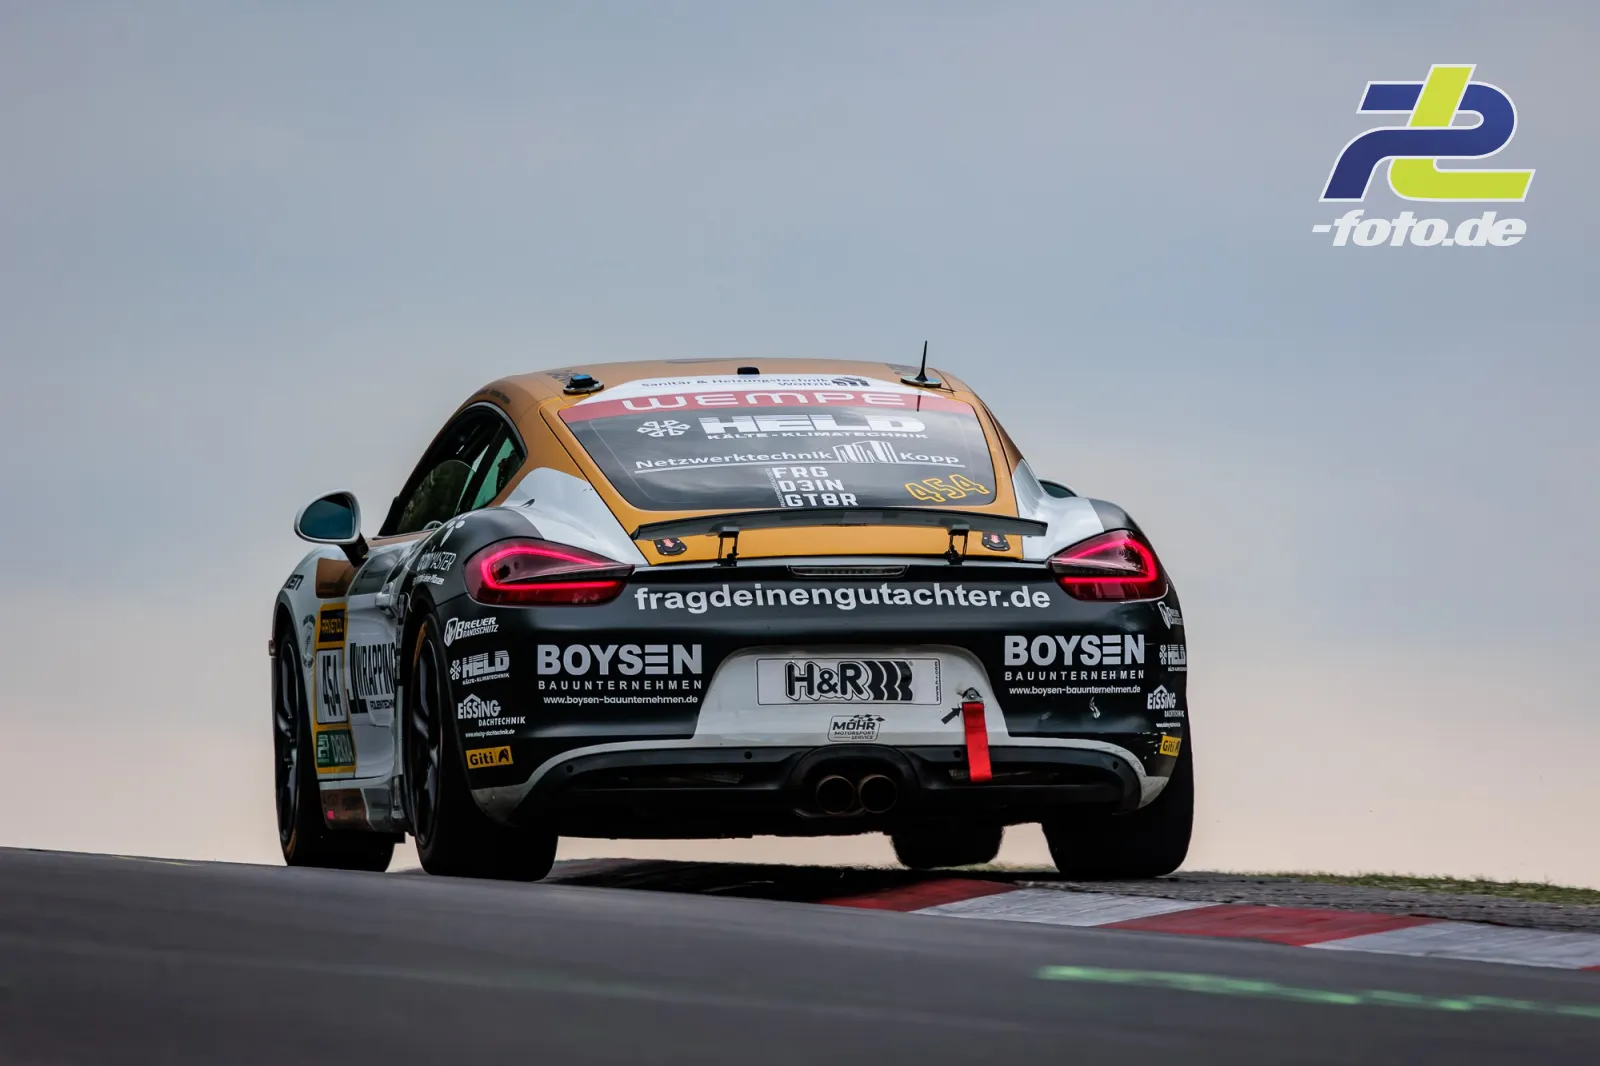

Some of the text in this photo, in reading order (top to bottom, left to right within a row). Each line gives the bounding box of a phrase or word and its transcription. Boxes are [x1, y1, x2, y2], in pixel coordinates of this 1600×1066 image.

[622, 392, 906, 411] WEMPE
[698, 414, 926, 434] HELD
[635, 451, 960, 469] Netzwerktechnik Kopp
[771, 466, 829, 479] FRG
[779, 480, 845, 493] D3IN
[905, 474, 991, 503] 454
[785, 493, 859, 507] GT8R
[634, 583, 1051, 614] fragdeinengutachter.de
[1004, 634, 1145, 666] BOYSEN
[462, 650, 510, 678] HELD
[537, 644, 703, 676] BOYSEN
[786, 661, 868, 700] H&R
[1004, 670, 1145, 681] BAUUNTERNEHMEN
[322, 655, 344, 717] 454
[538, 680, 702, 691] BAUUNTERNEHMEN
[1009, 685, 1141, 697] www.boysen-bauunternehmen.de
[543, 695, 699, 706] www.boysen-bauunternehmen.de
[478, 716, 526, 727] DACHTECHNIK
[469, 751, 495, 766] Giti
